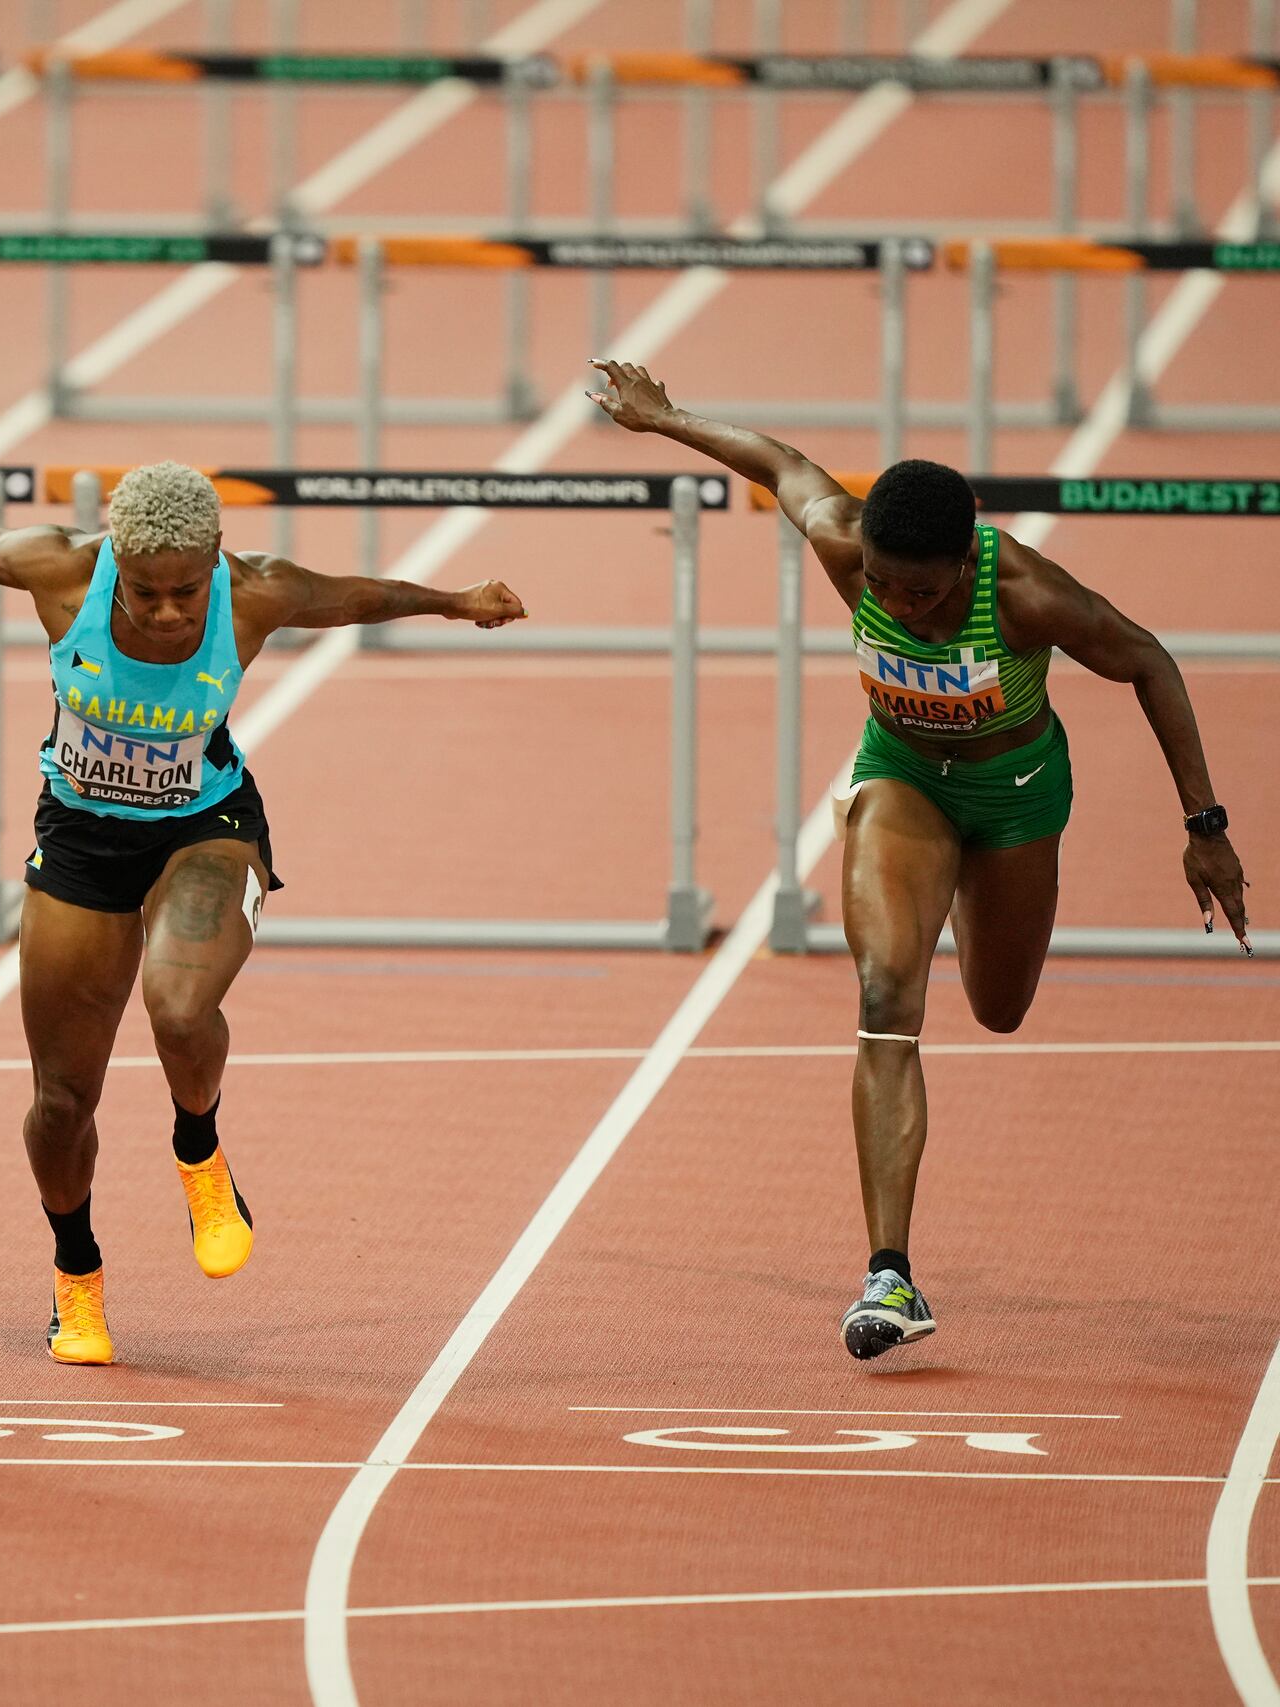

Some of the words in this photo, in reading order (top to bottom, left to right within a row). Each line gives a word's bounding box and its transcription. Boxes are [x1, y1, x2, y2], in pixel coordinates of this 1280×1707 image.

[295, 477, 372, 499] WORLD
[373, 478, 480, 500] ATHLETICS
[481, 479, 650, 502] CHAMPIONSHIPS
[1059, 479, 1253, 510] BUDAPEST
[877, 651, 971, 694] NTN
[67, 685, 218, 734] BAHAMAS
[870, 685, 994, 721] AMUSAN
[81, 724, 179, 766] NTN
[61, 742, 193, 789] CHARLTON
[89, 786, 171, 805] BUDAPEST
[623, 1425, 1050, 1456] 5
